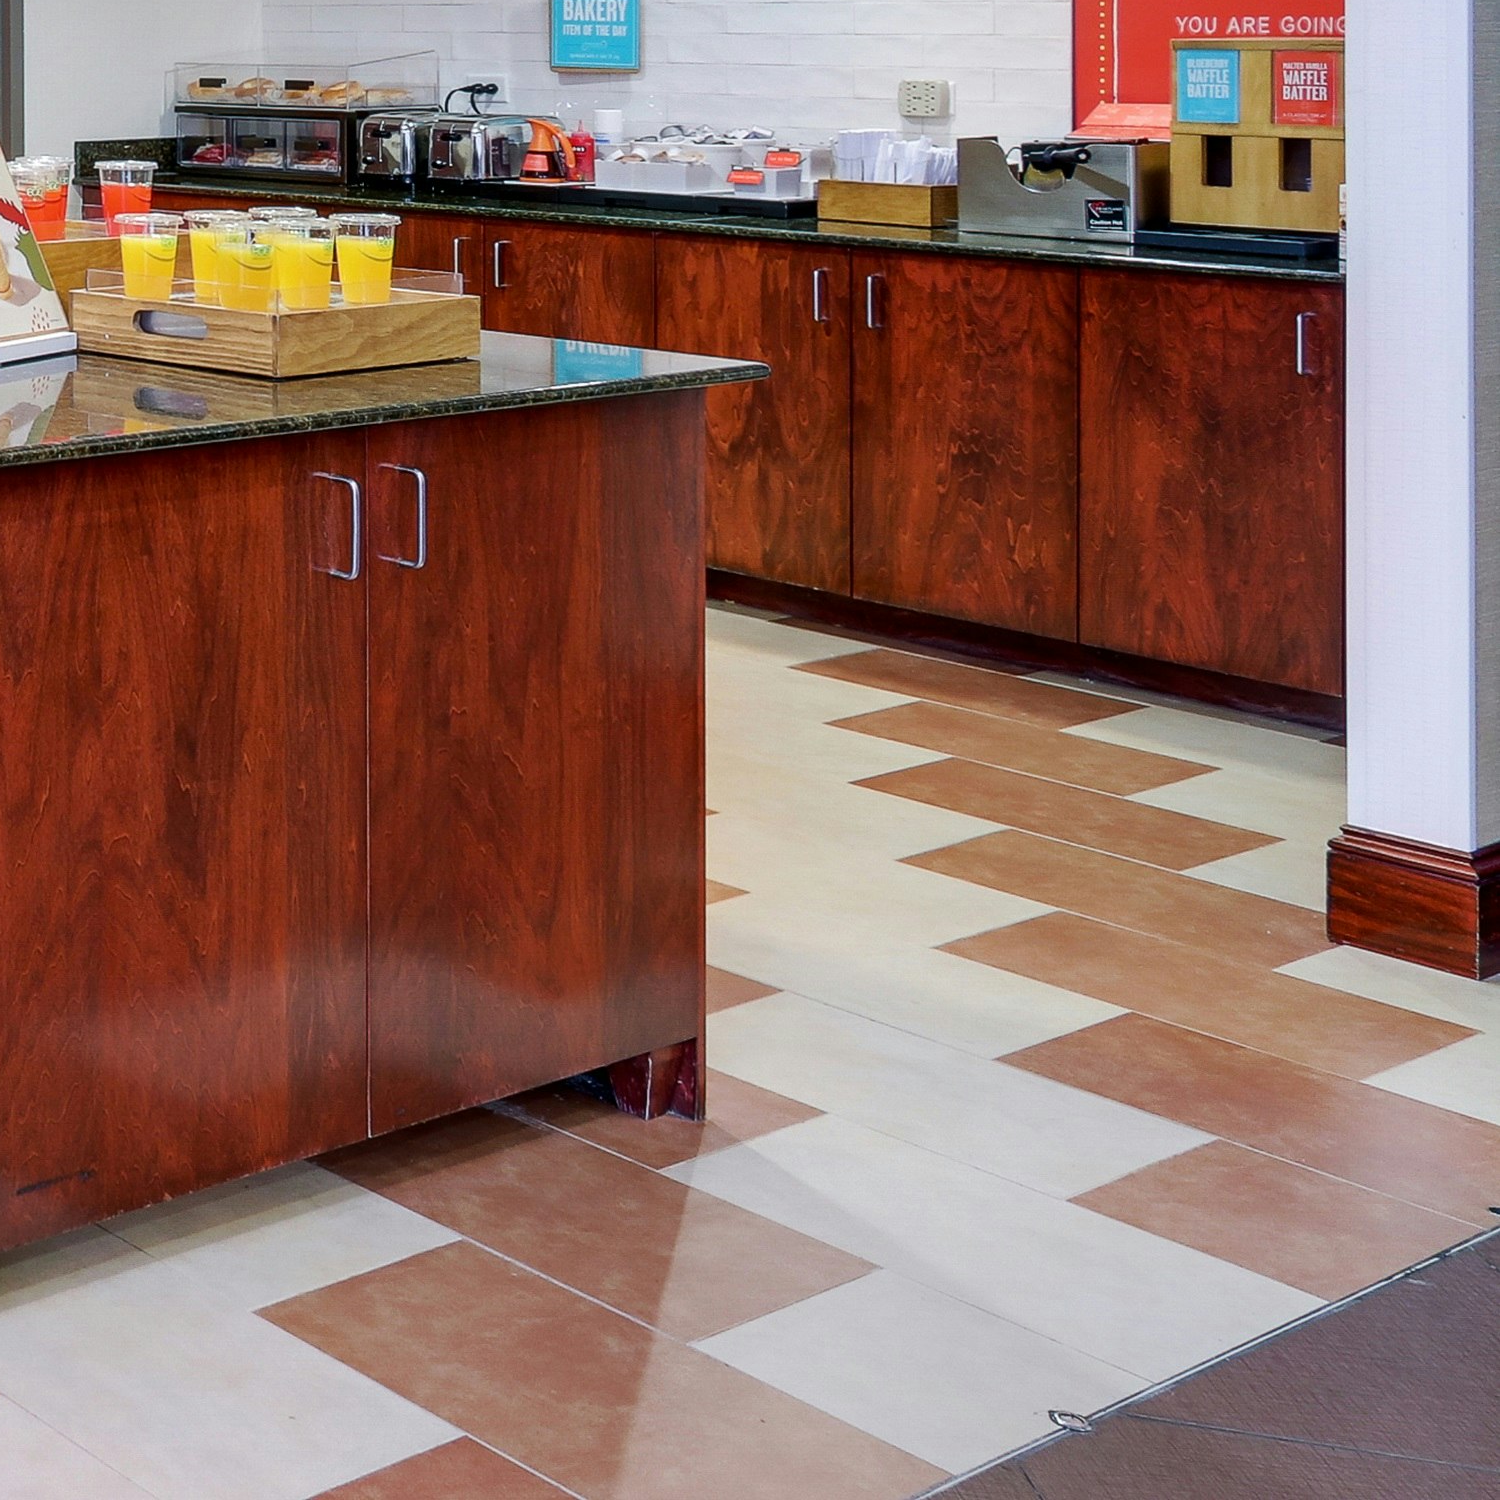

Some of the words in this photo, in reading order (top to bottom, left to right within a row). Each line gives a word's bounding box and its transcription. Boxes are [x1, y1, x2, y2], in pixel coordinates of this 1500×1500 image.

[562, 24, 581, 36] ITEM
[583, 24, 593, 36] OF
[595, 24, 610, 36] THE
[612, 24, 628, 37] DAY
[1176, 15, 1218, 34] YOU
[1226, 15, 1270, 34] ARE
[1187, 68, 1230, 84] WAFFLE
[1282, 70, 1328, 86] WAFFLE
[1187, 84, 1230, 99] BATTER
[1282, 85, 1328, 101] BATTER
